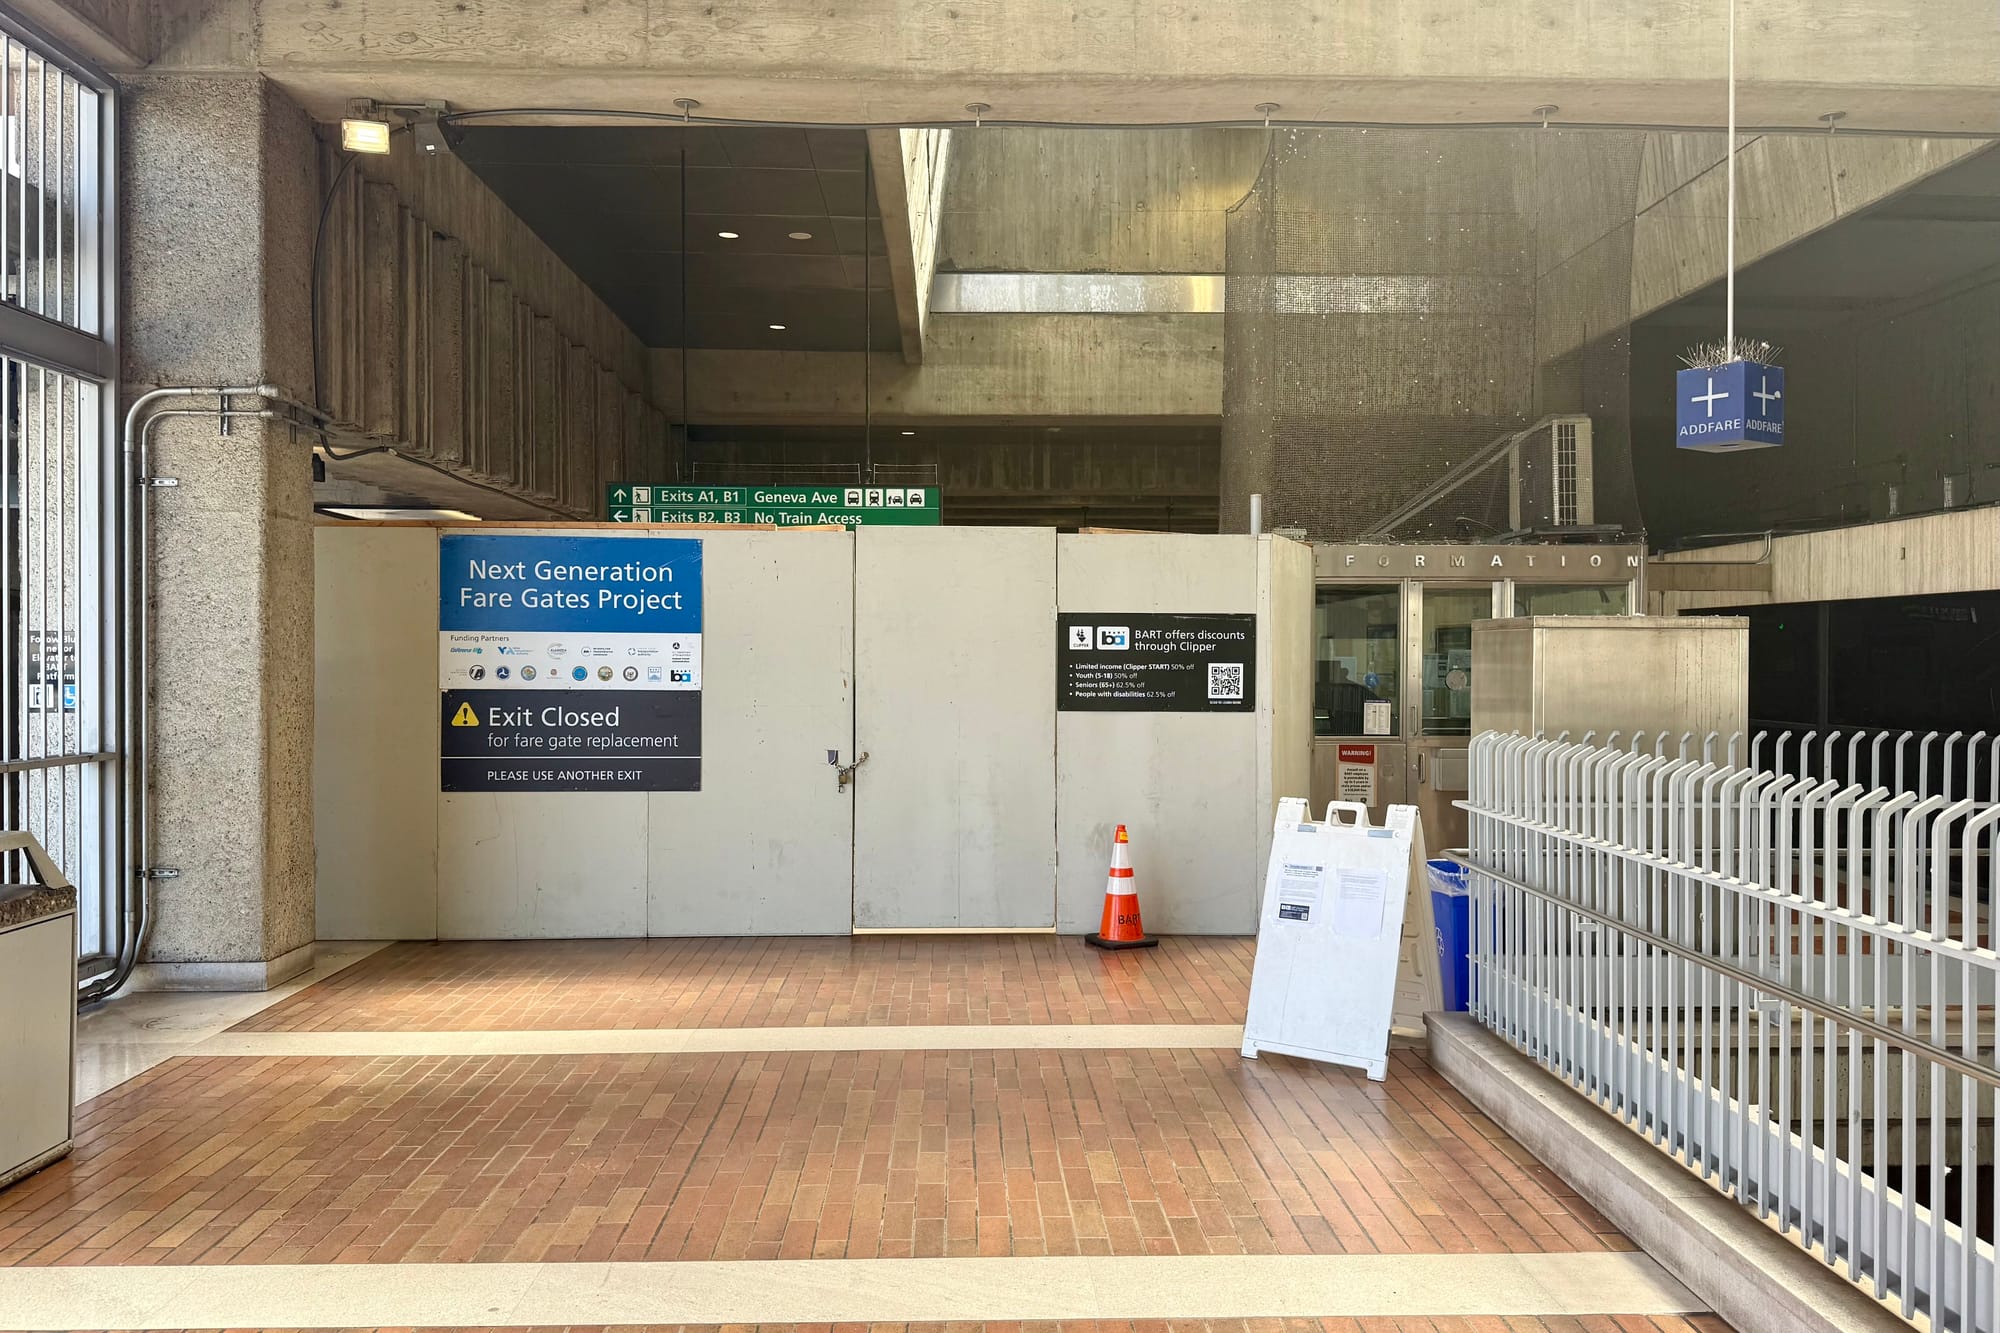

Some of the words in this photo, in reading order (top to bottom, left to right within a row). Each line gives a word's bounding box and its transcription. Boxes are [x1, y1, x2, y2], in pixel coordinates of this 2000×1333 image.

[1679, 418, 1741, 436] ADDFARE
[1746, 418, 1783, 434] ADDFARE
[661, 491, 694, 502] Exits
[698, 491, 719, 504] A1,
[723, 491, 739, 502] B1
[754, 491, 808, 503] Geneva
[811, 492, 838, 504] Ave
[661, 512, 694, 523] Exits
[698, 512, 720, 524] B2,
[724, 512, 741, 524] B3
[754, 512, 775, 524] No
[778, 512, 814, 524] Train
[817, 513, 863, 525] Access
[468, 559, 526, 580] Next
[534, 560, 673, 582] Generation
[459, 587, 513, 608] Fare
[521, 588, 591, 609] Gates
[598, 589, 683, 615] Project
[30, 635, 59, 643] Foow
[450, 634, 479, 643] Funding
[1135, 630, 1162, 640] BART
[1164, 630, 1195, 640] offers
[1197, 630, 1245, 641] discounts
[1135, 641, 1176, 652] through
[1180, 642, 1217, 653] Clipper
[1123, 663, 1148, 671] (Clipper
[1148, 663, 1170, 671] START)
[1095, 672, 1113, 680] (5-18)
[488, 707, 533, 727] Exit
[541, 706, 620, 727] Closed
[488, 733, 510, 747] for
[514, 733, 544, 747] fare
[548, 734, 582, 750] gate
[587, 733, 679, 750] replacement
[487, 771, 529, 781] PLEASE
[532, 771, 554, 781] USE
[557, 771, 614, 781] ANOTHER
[617, 771, 643, 781] EXIT
